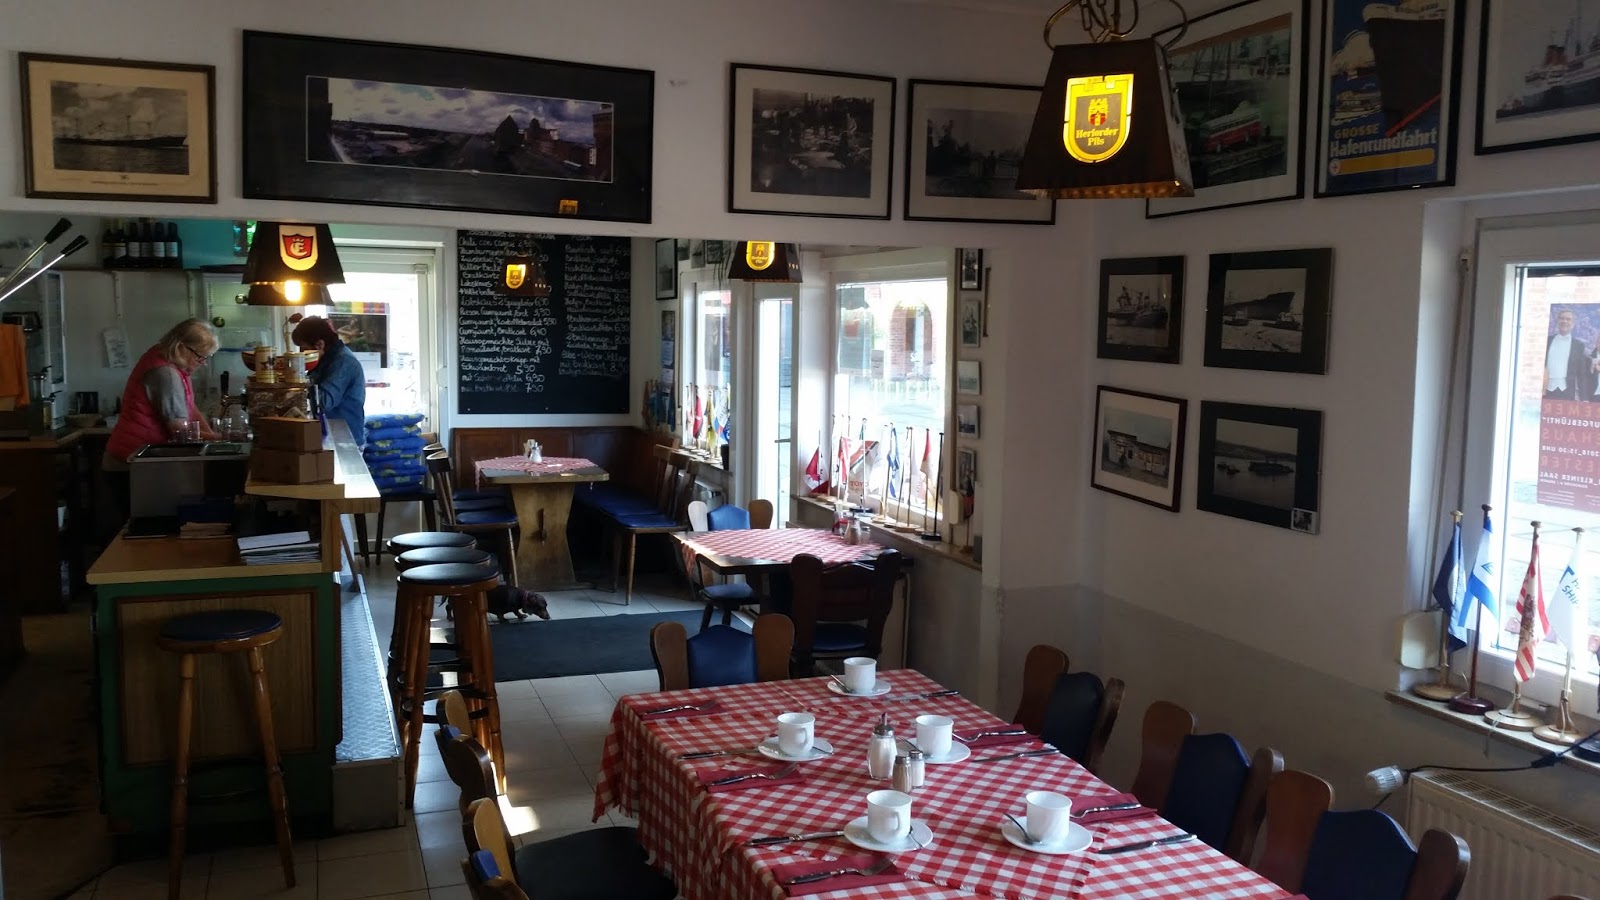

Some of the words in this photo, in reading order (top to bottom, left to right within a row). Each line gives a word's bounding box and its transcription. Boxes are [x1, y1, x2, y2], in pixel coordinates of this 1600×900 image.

[1076, 127, 1119, 139] Herforder
[1335, 123, 1380, 139] GROSSE
[1088, 137, 1105, 146] Pils
[1330, 127, 1437, 157] Hafenrundfahrt
